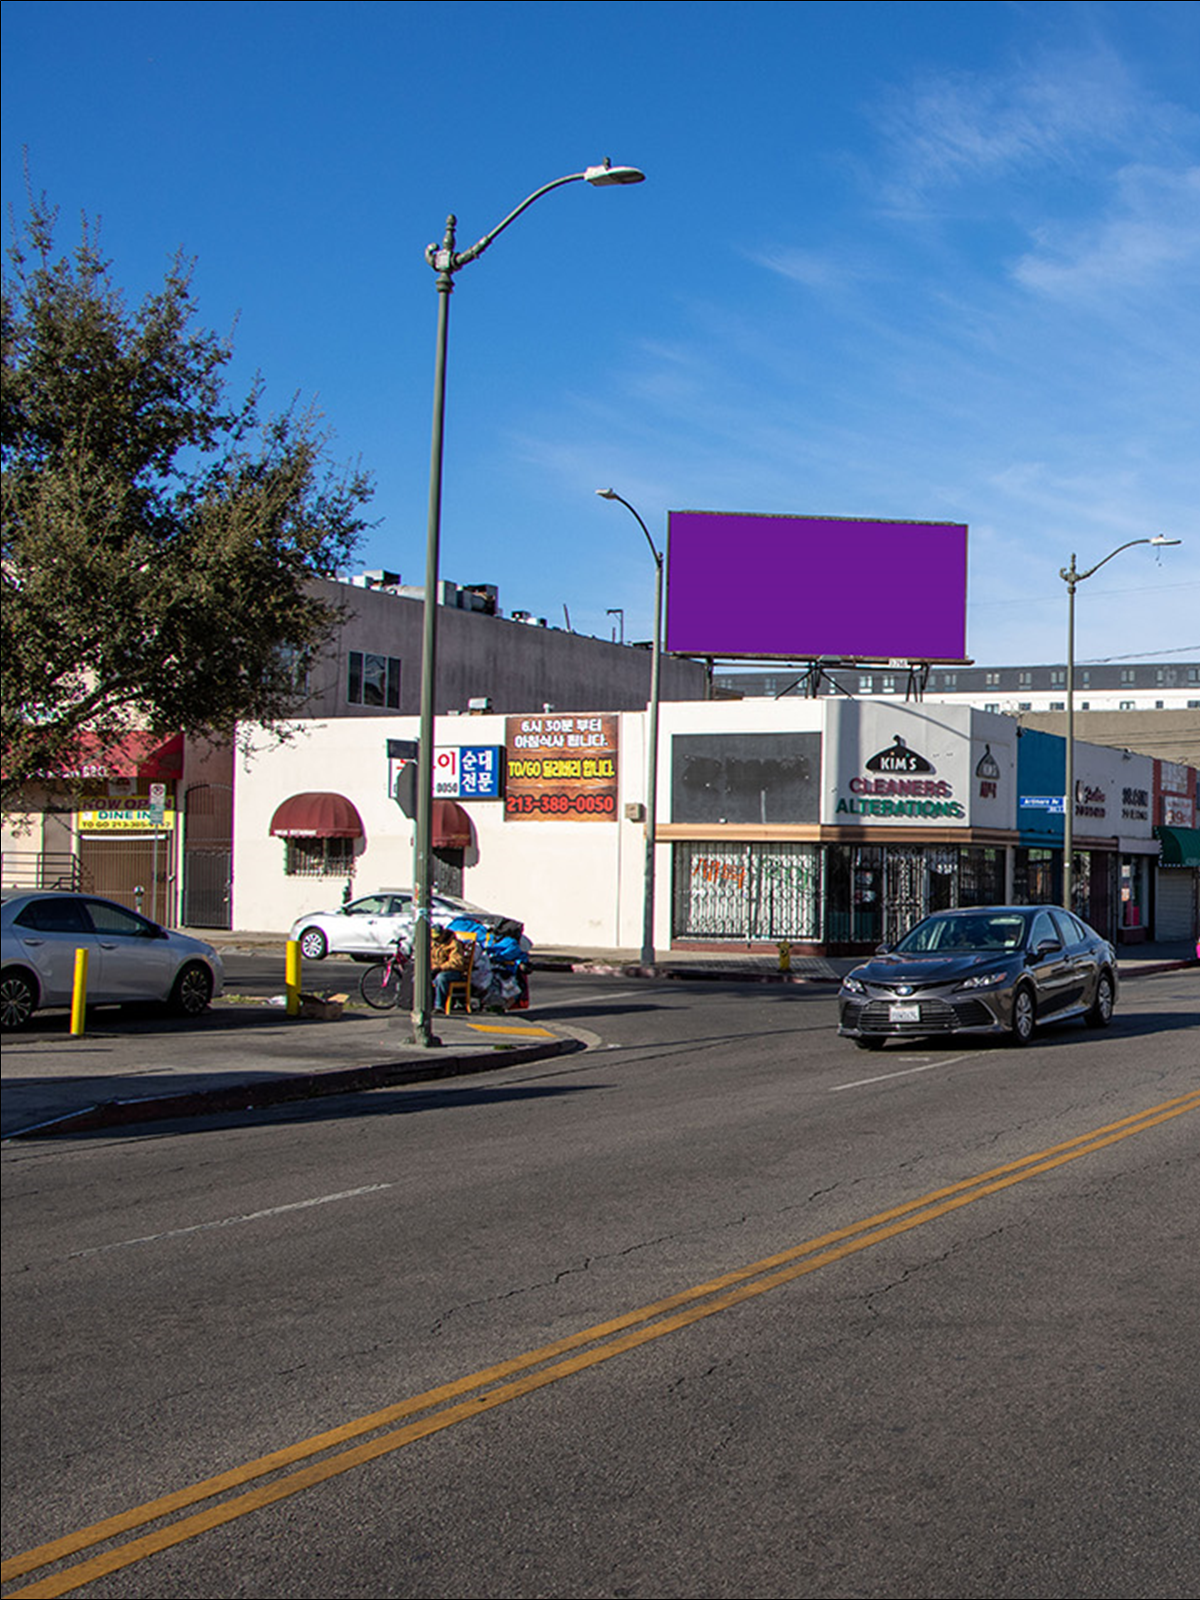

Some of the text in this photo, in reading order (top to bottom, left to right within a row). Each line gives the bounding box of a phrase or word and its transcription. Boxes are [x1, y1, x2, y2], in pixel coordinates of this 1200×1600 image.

[521, 718, 602, 732] 6시 30분 부터
[514, 734, 564, 748] 아침식사
[461, 750, 493, 771] 순대
[508, 760, 541, 777] TO/GO
[461, 772, 494, 792] 전문
[849, 777, 948, 797] CLEANERS
[82, 798, 173, 809] NOW OPN
[506, 795, 614, 812] 213-388-0050
[835, 798, 962, 816] ALTERATIONS
[98, 810, 151, 820] DINE IN
